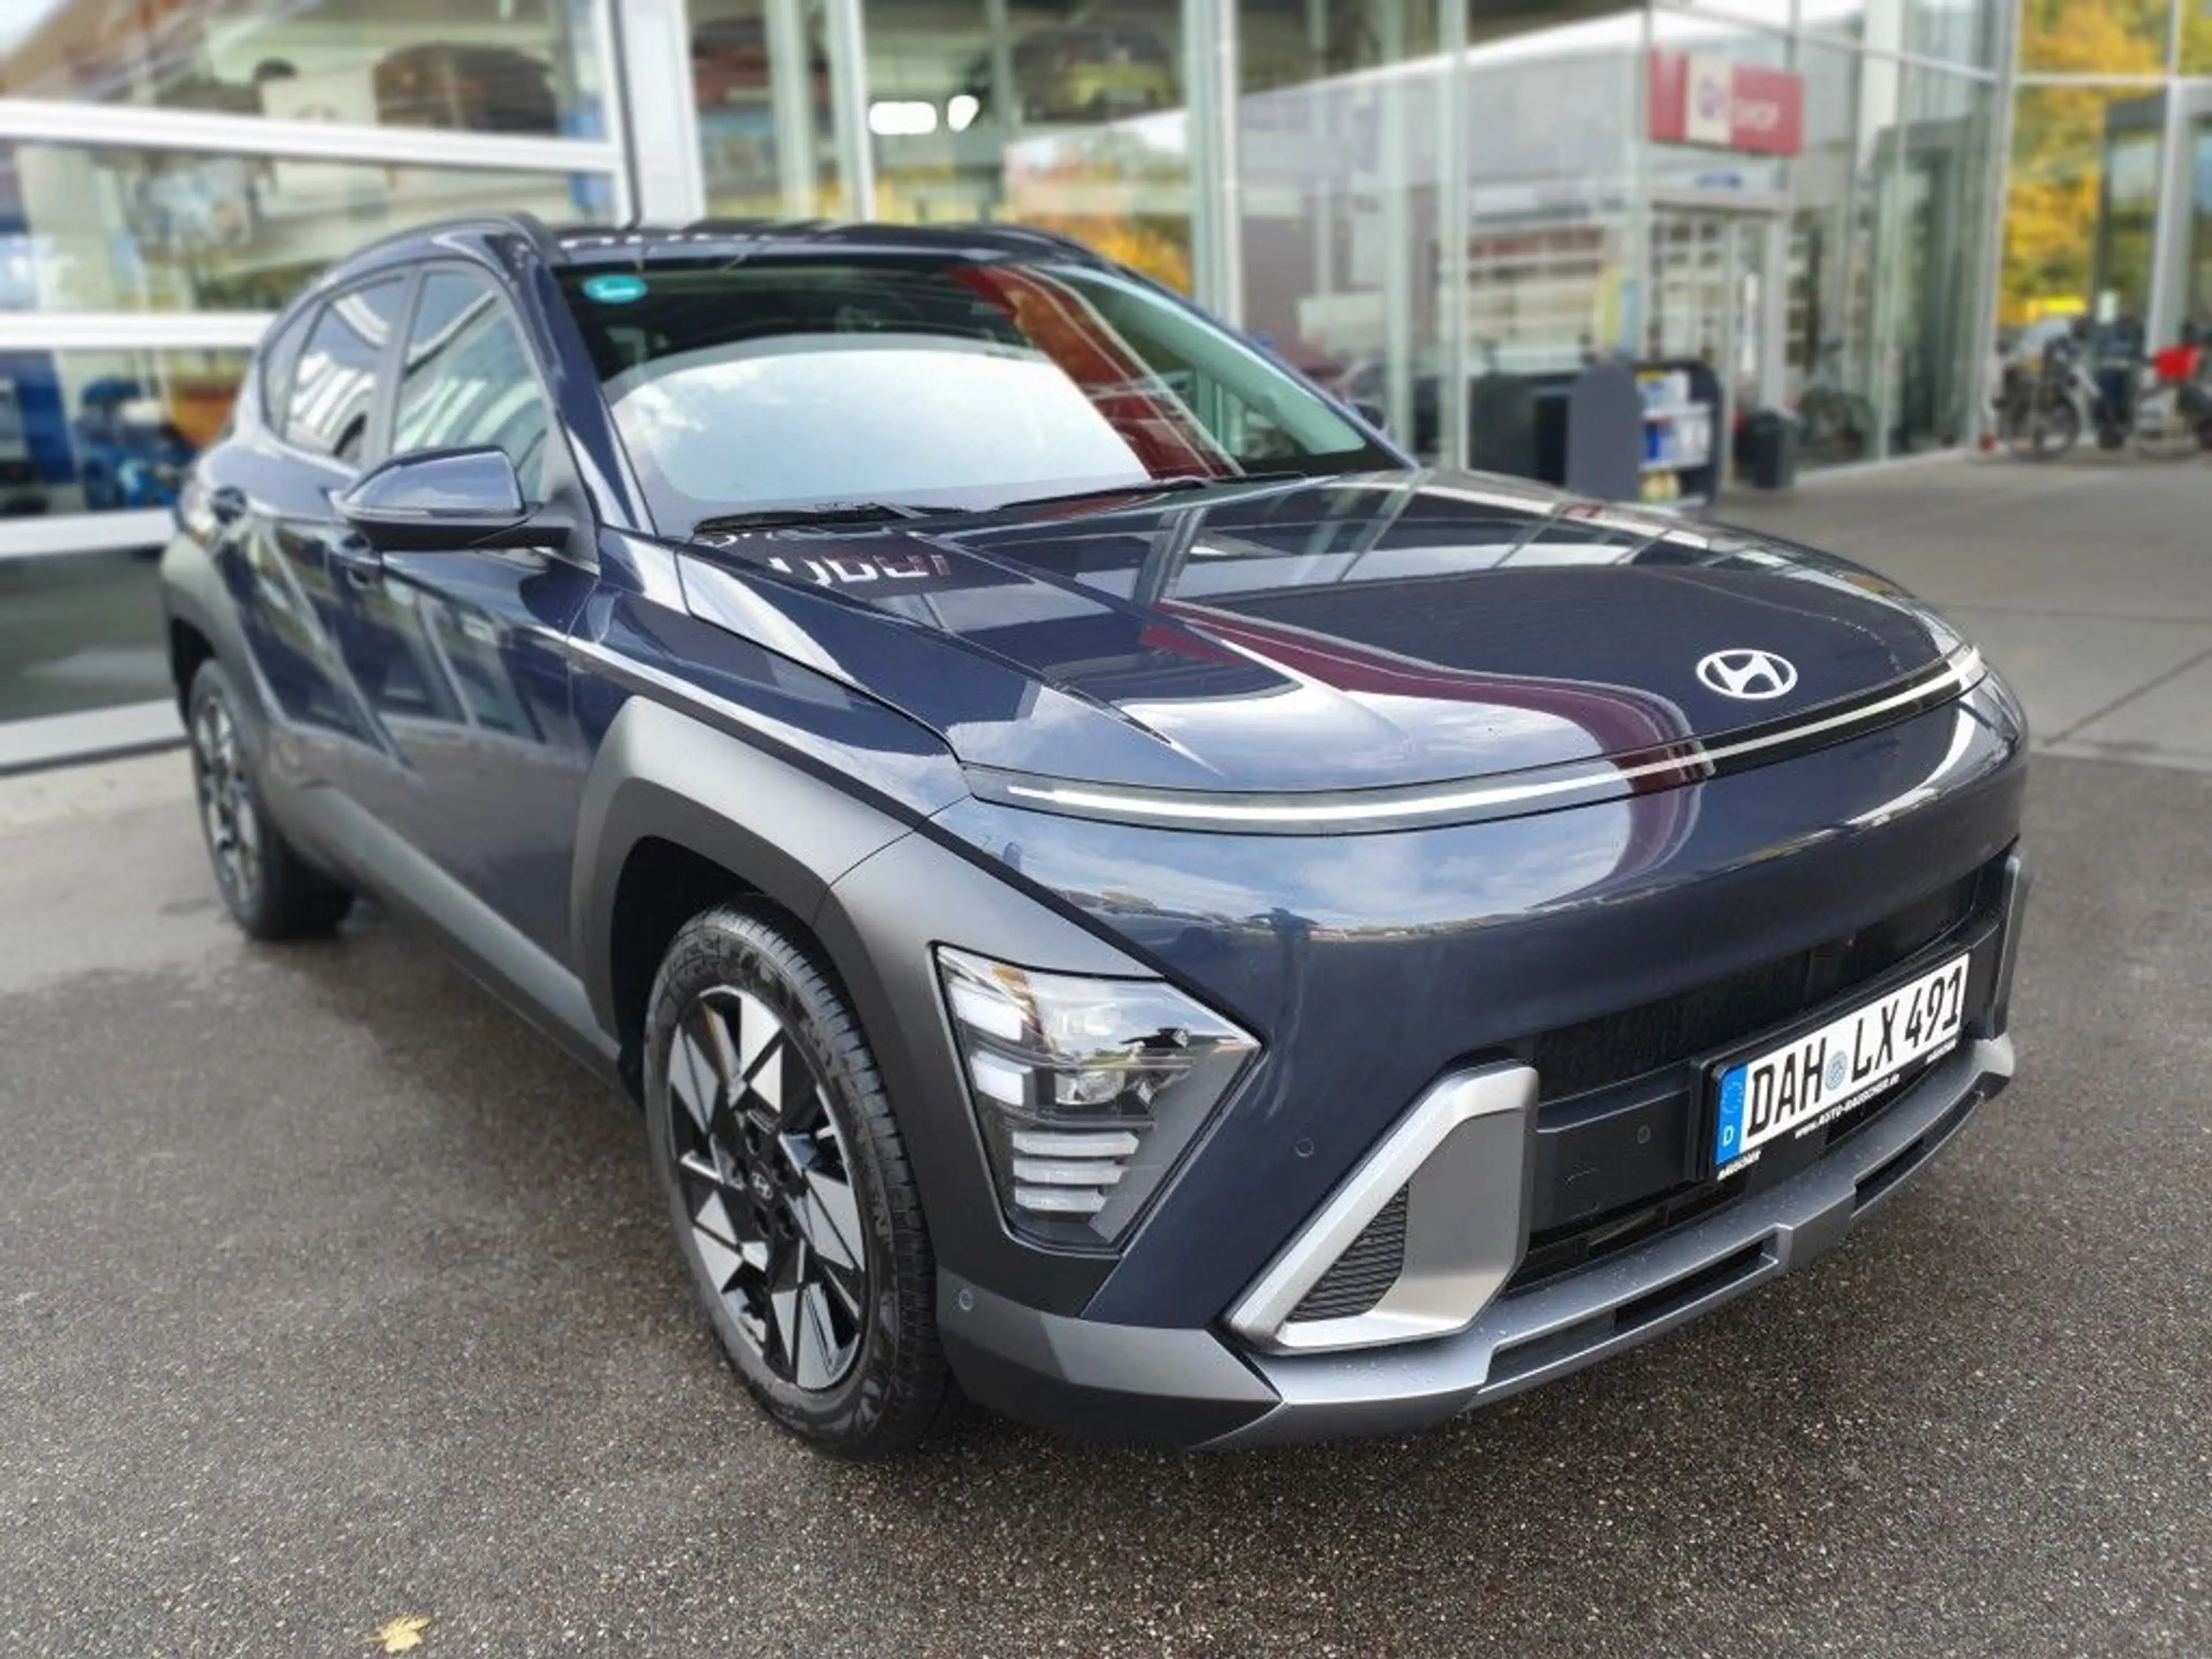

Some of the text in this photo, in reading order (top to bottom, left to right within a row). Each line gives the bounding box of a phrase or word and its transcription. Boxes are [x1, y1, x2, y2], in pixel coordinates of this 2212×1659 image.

[1747, 1037, 1827, 1138] DAH
[1851, 999, 1899, 1082] LX
[1905, 965, 1962, 1048] 491
[1722, 1125, 1734, 1146] D
